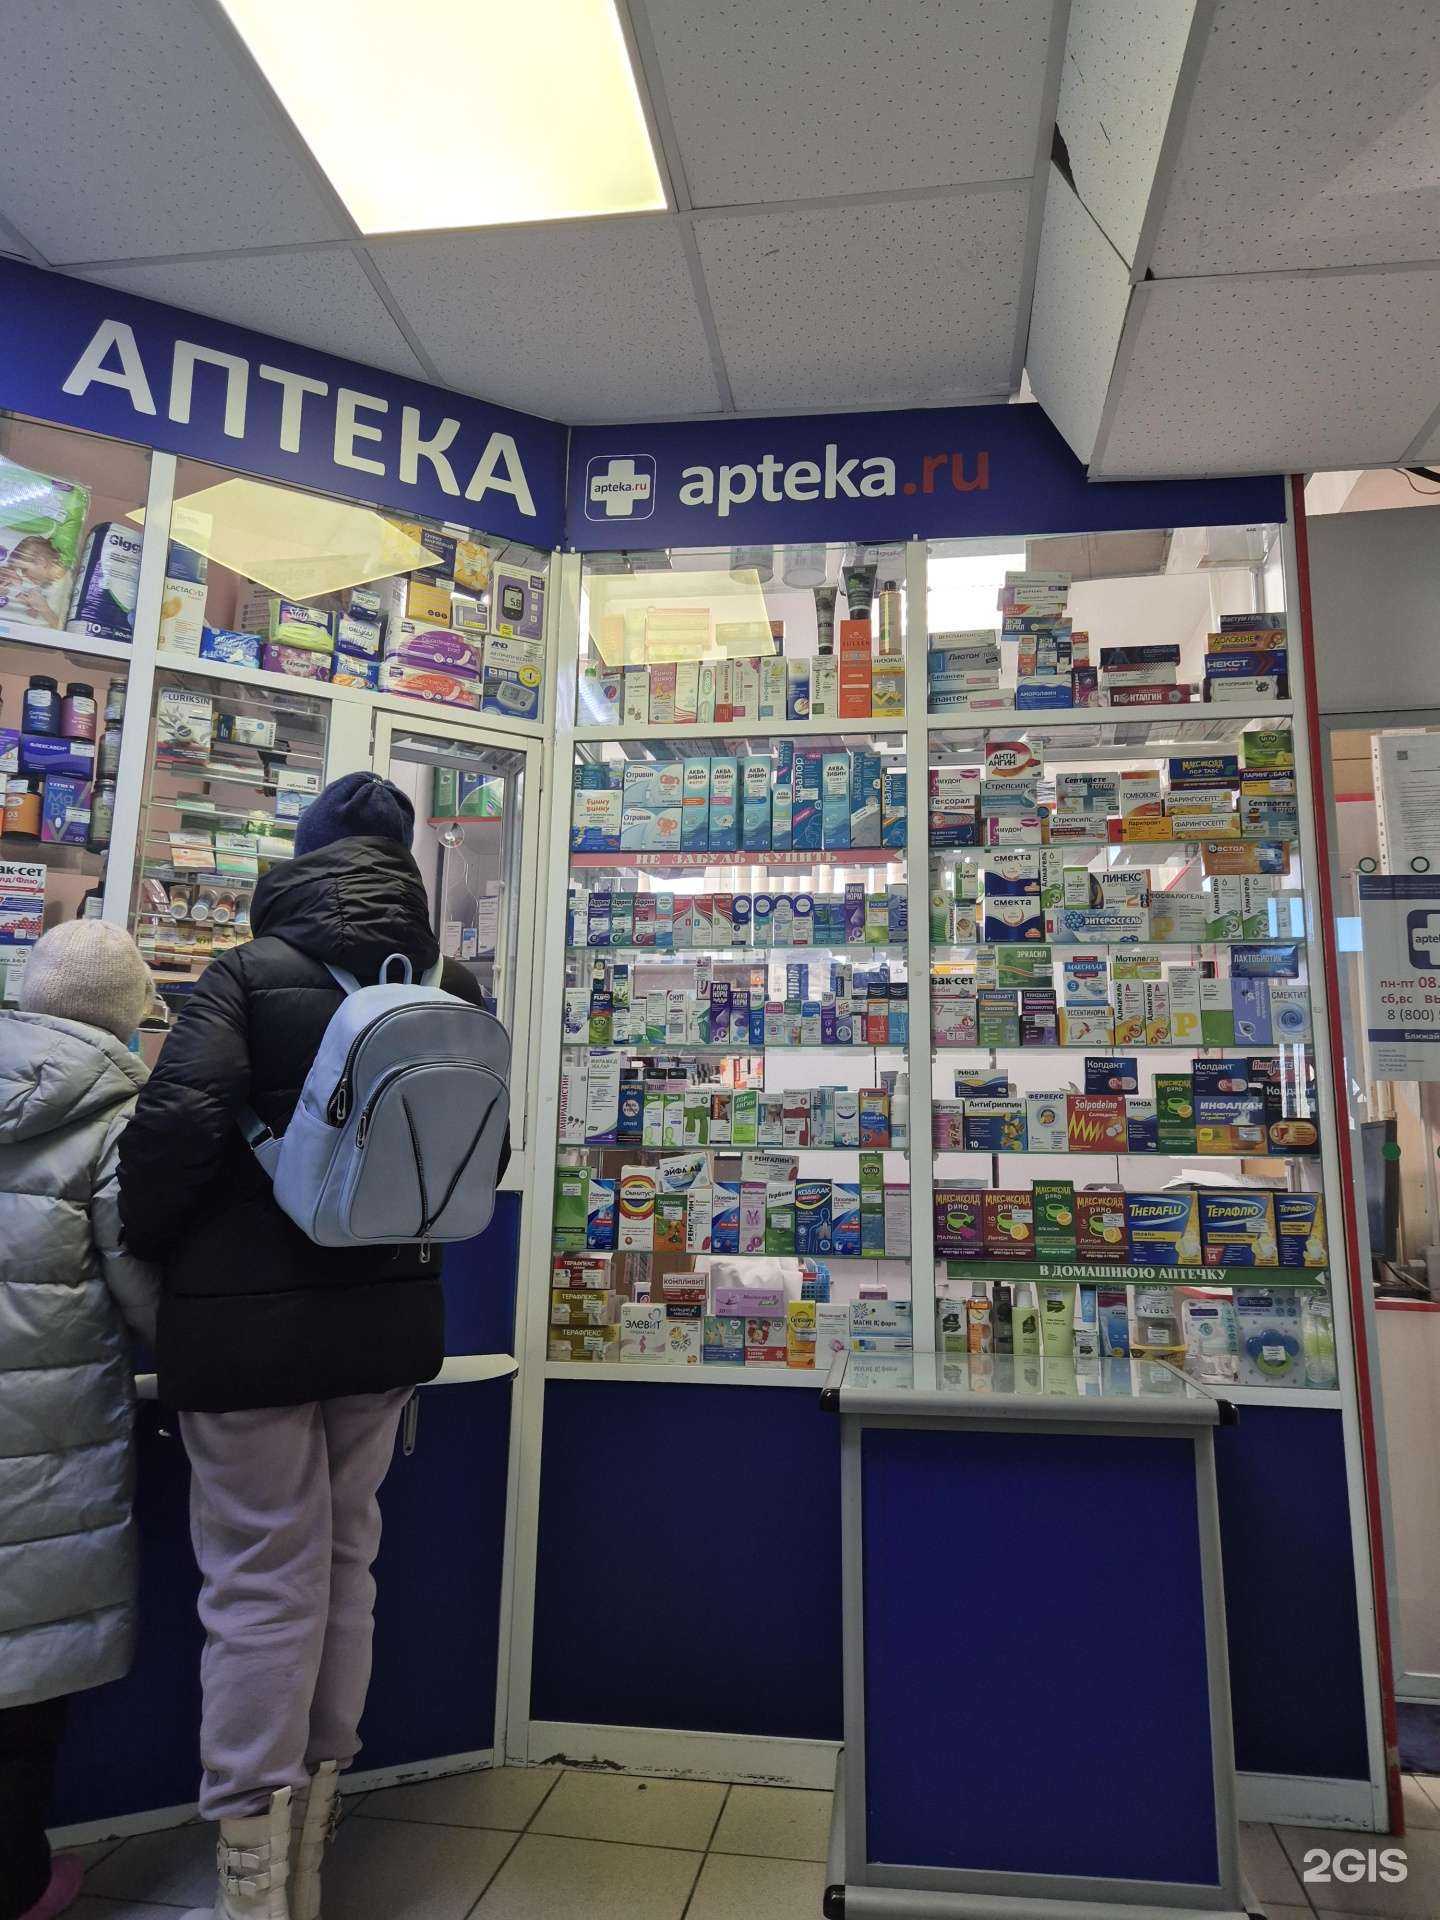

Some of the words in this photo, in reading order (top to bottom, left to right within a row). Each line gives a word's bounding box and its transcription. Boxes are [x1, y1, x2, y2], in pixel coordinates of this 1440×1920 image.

[62, 319, 537, 516] АПТЕКА
[680, 444, 989, 516] apteka.ru
[594, 480, 647, 494] apteka.ru
[636, 854, 661, 865] НЕ
[673, 852, 747, 864] ЗАБУДЬ
[758, 851, 838, 863] КУПИТЬ
[994, 854, 1031, 862] смекта
[0, 865, 43, 876] ак-сет
[1102, 873, 1142, 884] ЛИНЕКС
[1416, 934, 1440, 945] apte
[1380, 980, 1414, 988] пн-пт
[1271, 991, 1307, 999] СМЕКТИТ
[1387, 1009, 1395, 1020] 8
[1400, 1009, 1434, 1021] (800)
[969, 1101, 1022, 1109] АнтиГриппин
[1075, 1100, 1117, 1111] Solpadeine
[1129, 1204, 1182, 1216] THERAFLU
[1206, 1205, 1259, 1217] ТЕРАФЛЮ
[1040, 1265, 1049, 1275] В
[1052, 1265, 1155, 1279] ДОМАШНЮЮ
[1159, 1268, 1227, 1280] АПТЕЧКУ
